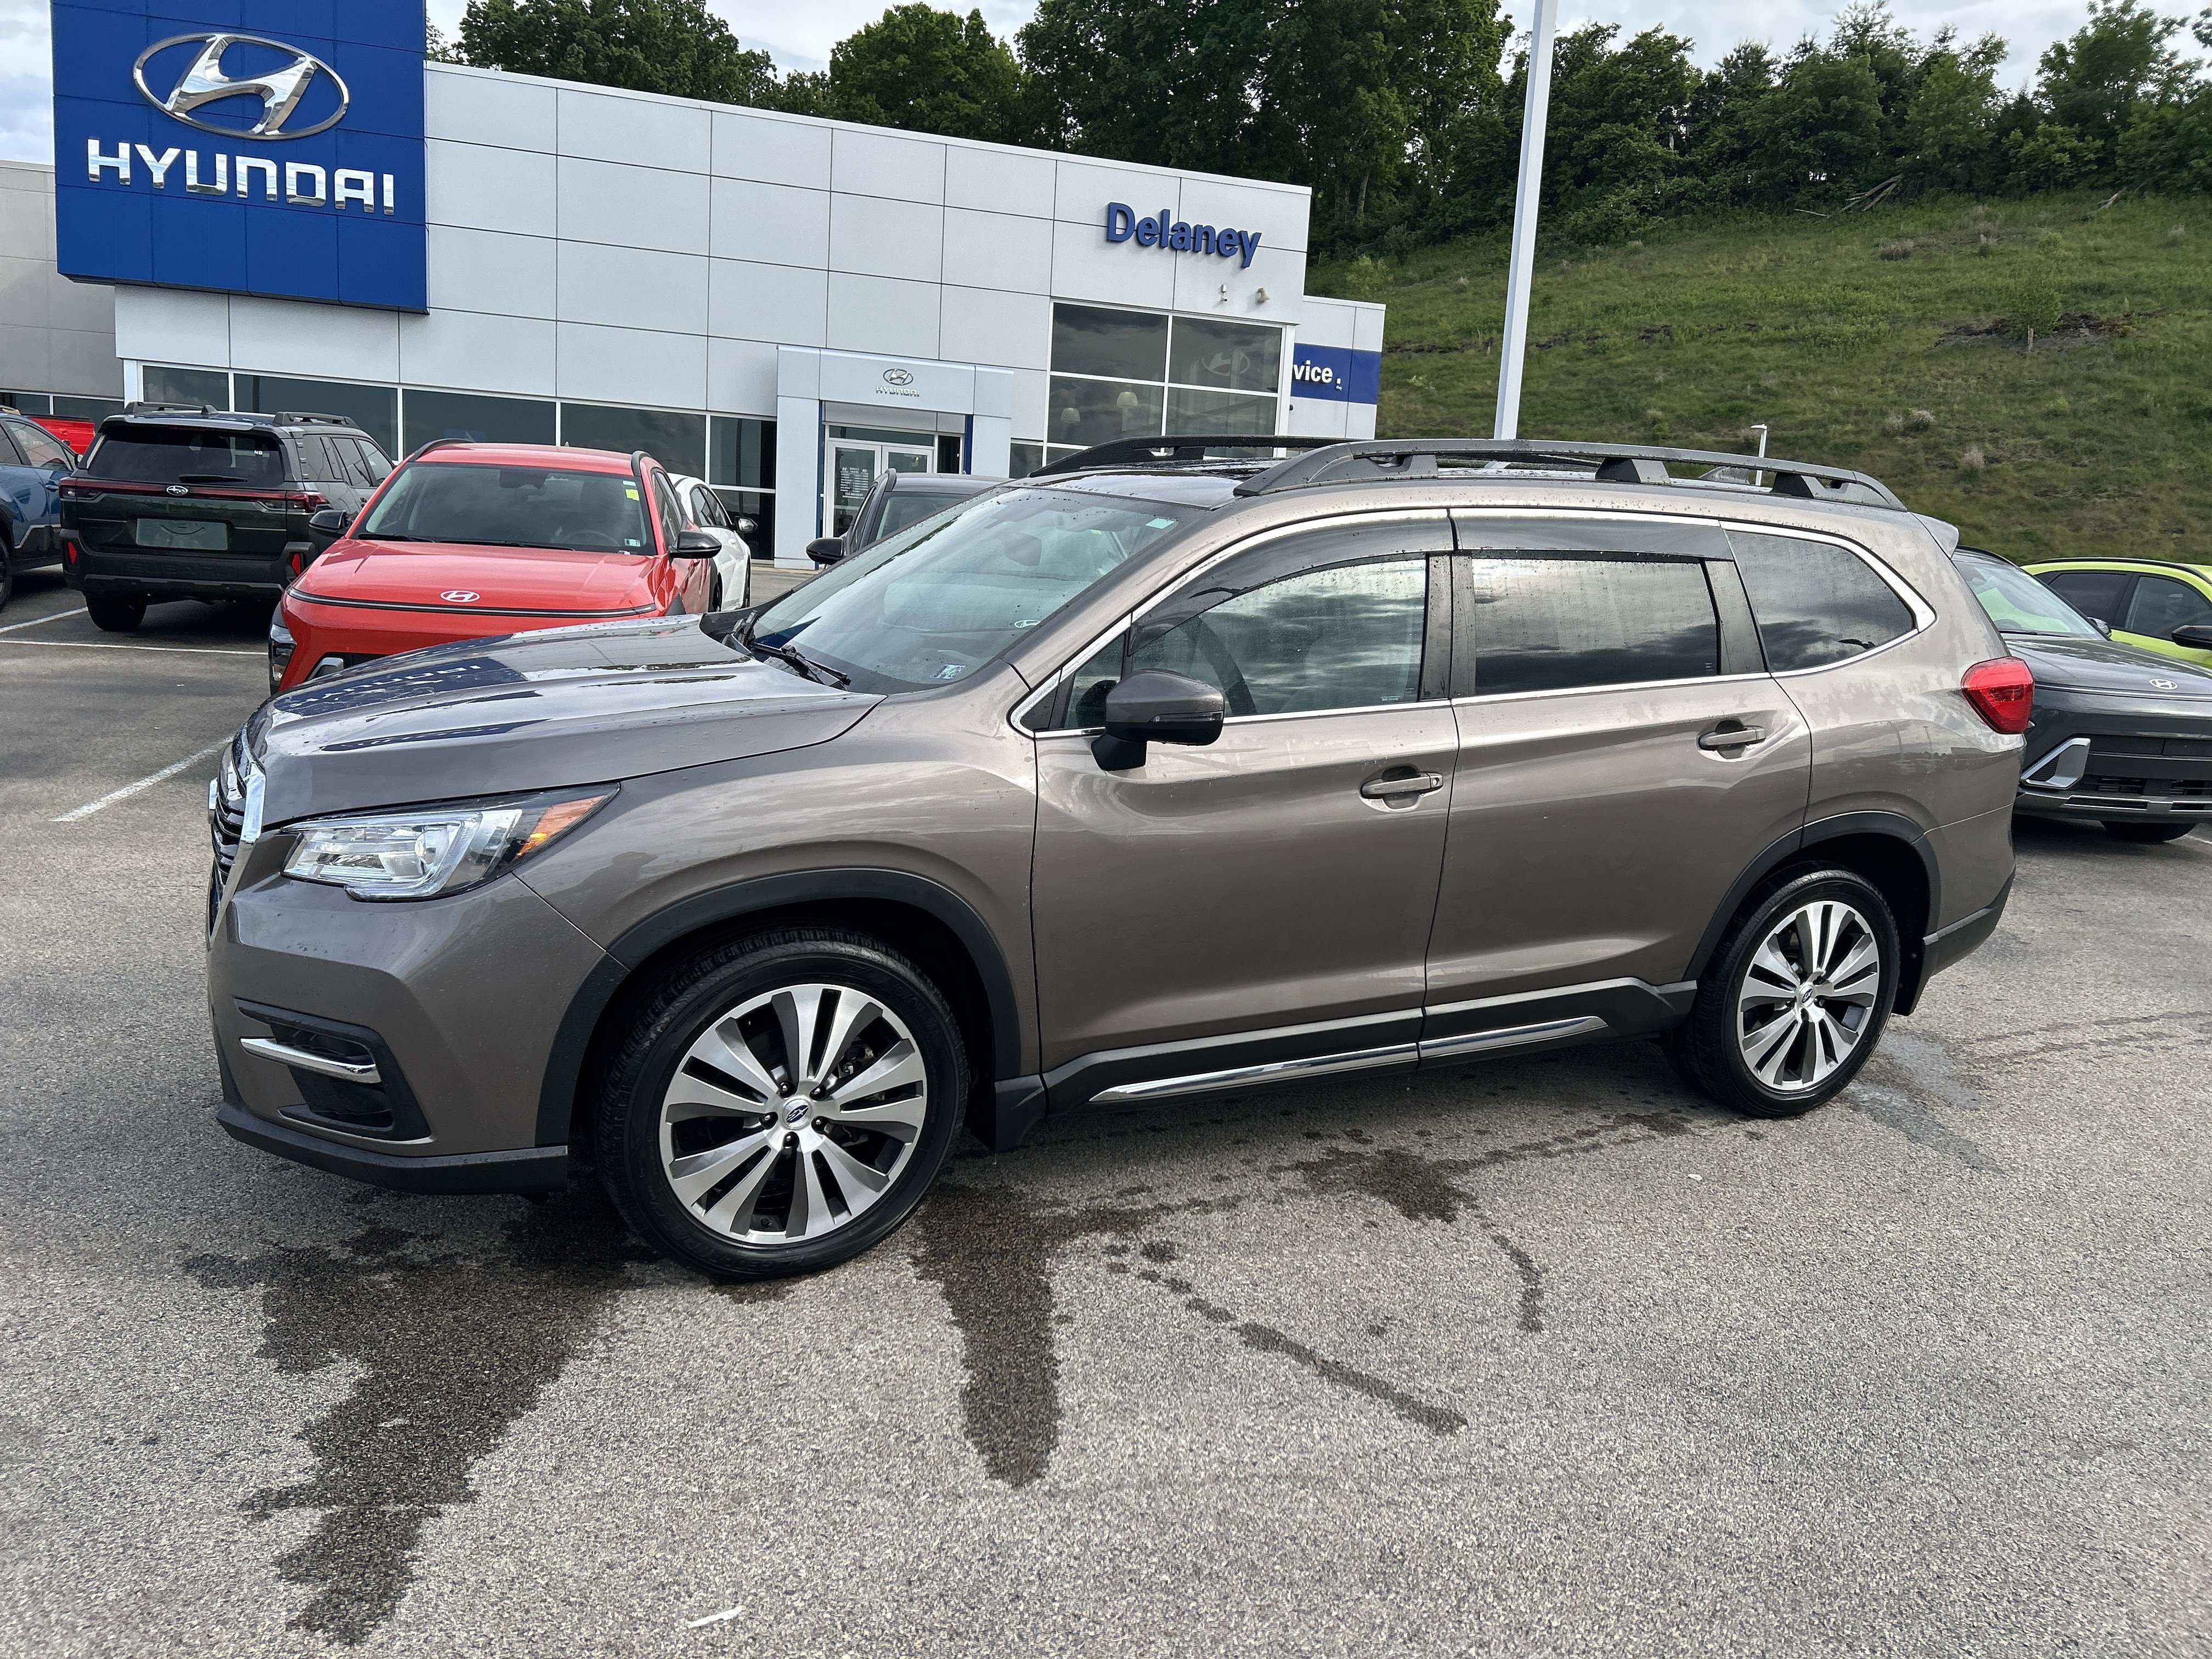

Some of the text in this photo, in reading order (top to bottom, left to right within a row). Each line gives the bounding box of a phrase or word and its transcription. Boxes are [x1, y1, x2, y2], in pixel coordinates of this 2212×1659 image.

[88, 138, 394, 215] HYUNDAI
[1107, 202, 1262, 268] Delaney
[876, 386, 919, 397] HYUNDAI
